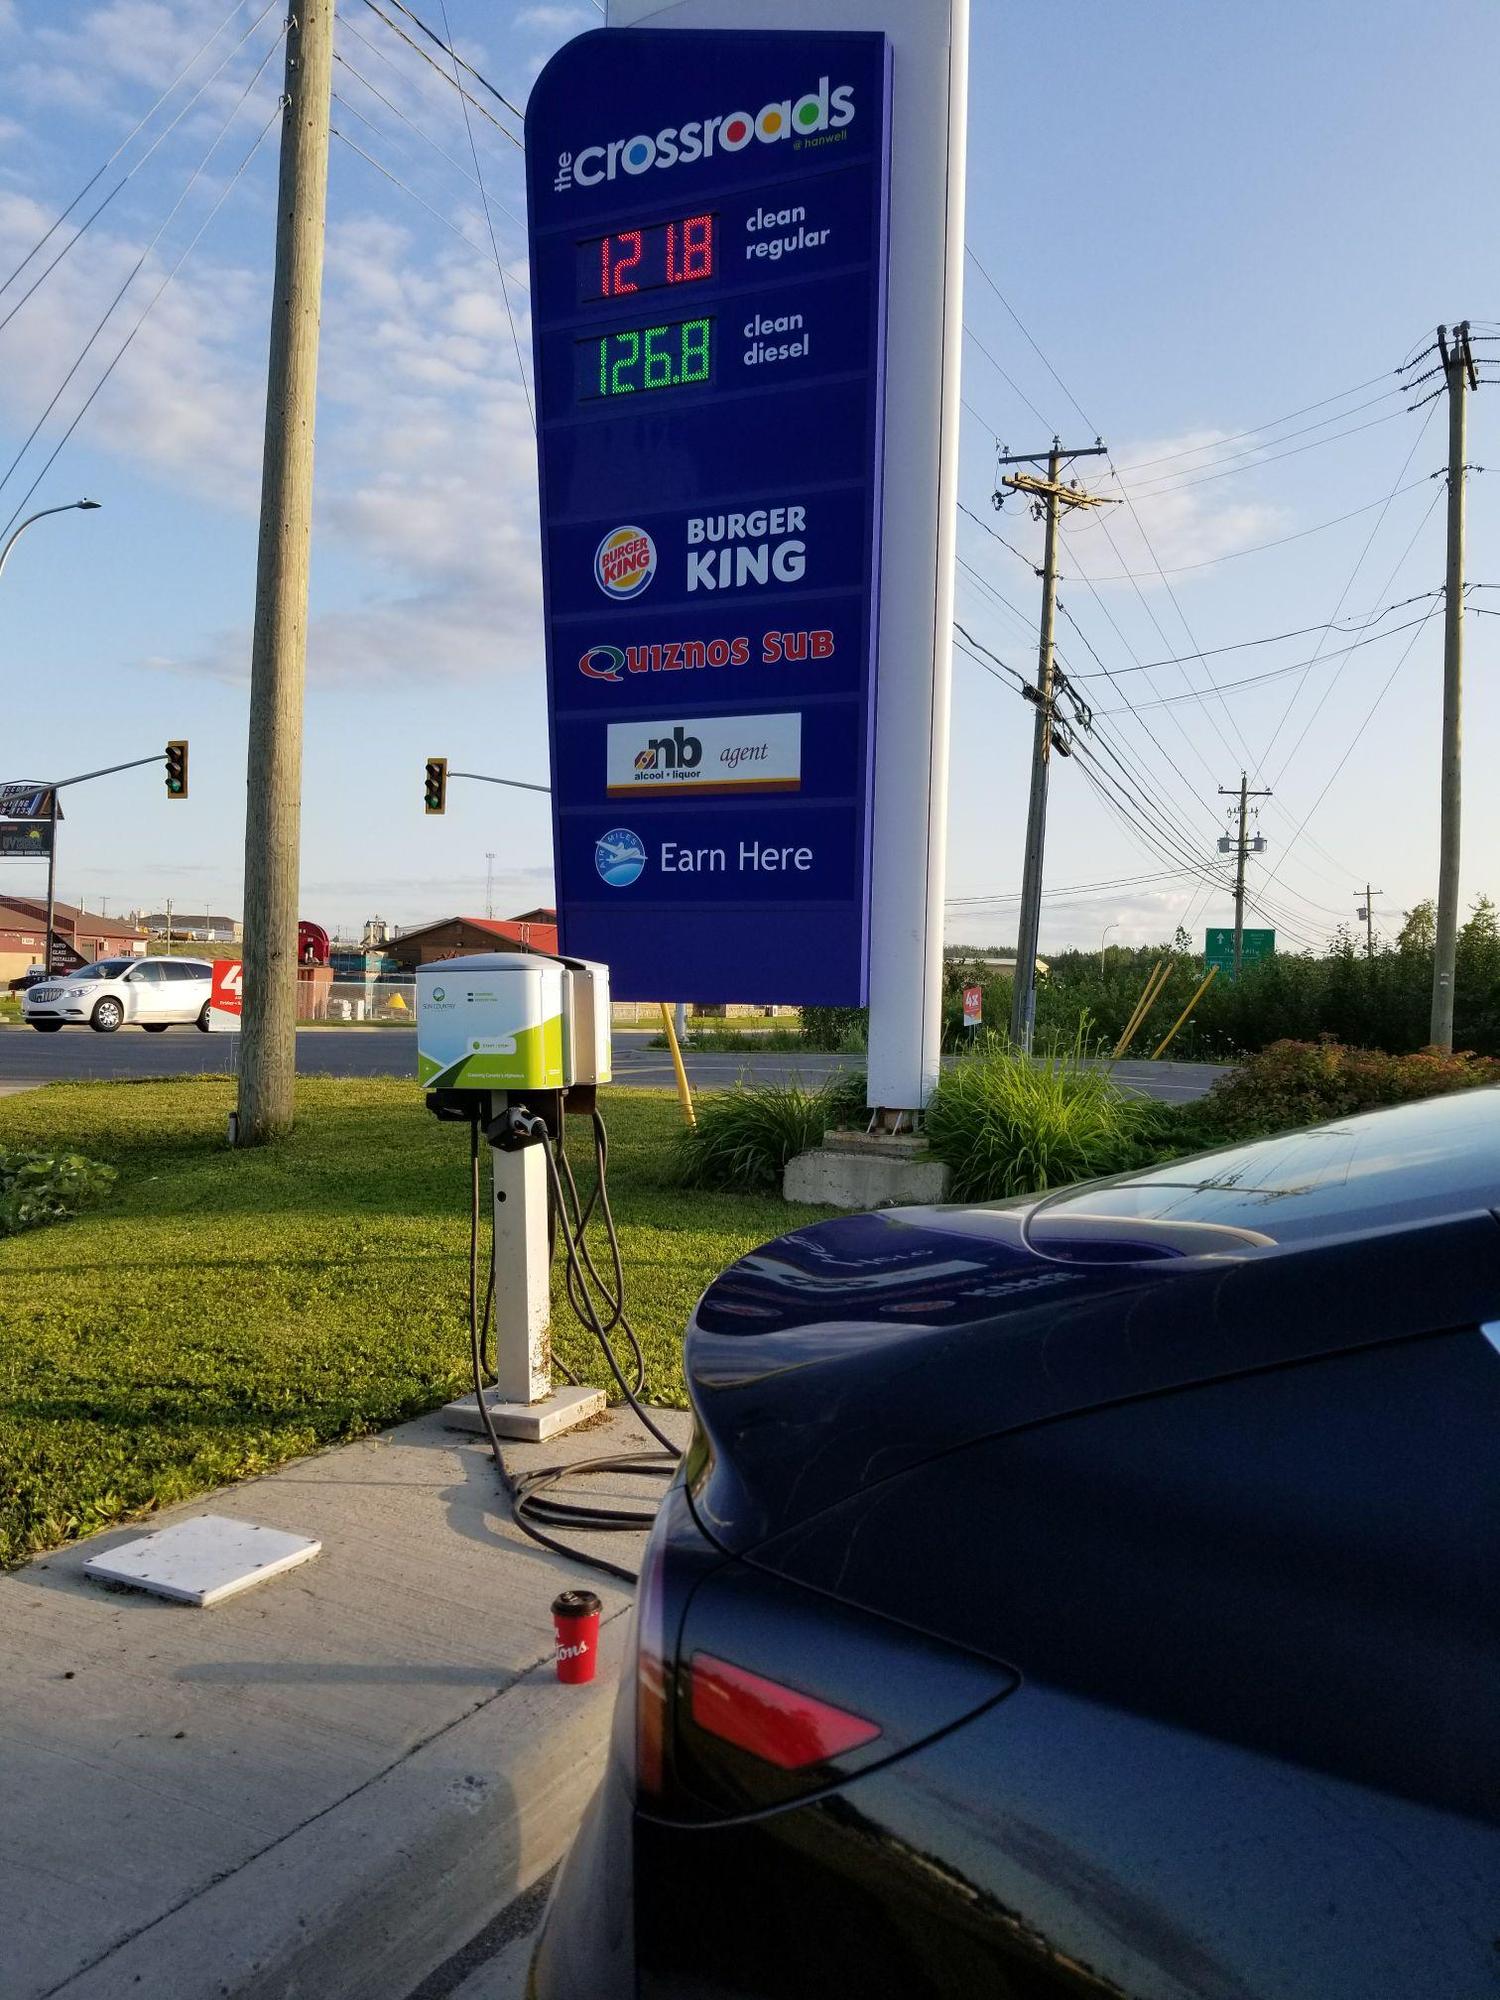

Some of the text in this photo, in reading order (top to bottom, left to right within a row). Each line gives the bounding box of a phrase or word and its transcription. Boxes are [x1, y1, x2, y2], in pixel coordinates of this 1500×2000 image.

[554, 76, 855, 192] the crossroads
[804, 130, 847, 149] hanwell
[746, 206, 806, 232] clean
[746, 227, 831, 261] regular
[743, 313, 803, 338] clean
[600, 319, 710, 395] 126.8
[743, 333, 810, 366] diesel
[687, 505, 807, 544] BURGER
[601, 537, 648, 568] BURGER
[603, 549, 650, 586] KING
[687, 540, 806, 592] KING
[719, 743, 768, 769] agent
[634, 770, 701, 781] alcool liquor
[661, 841, 814, 872] Earn Here
